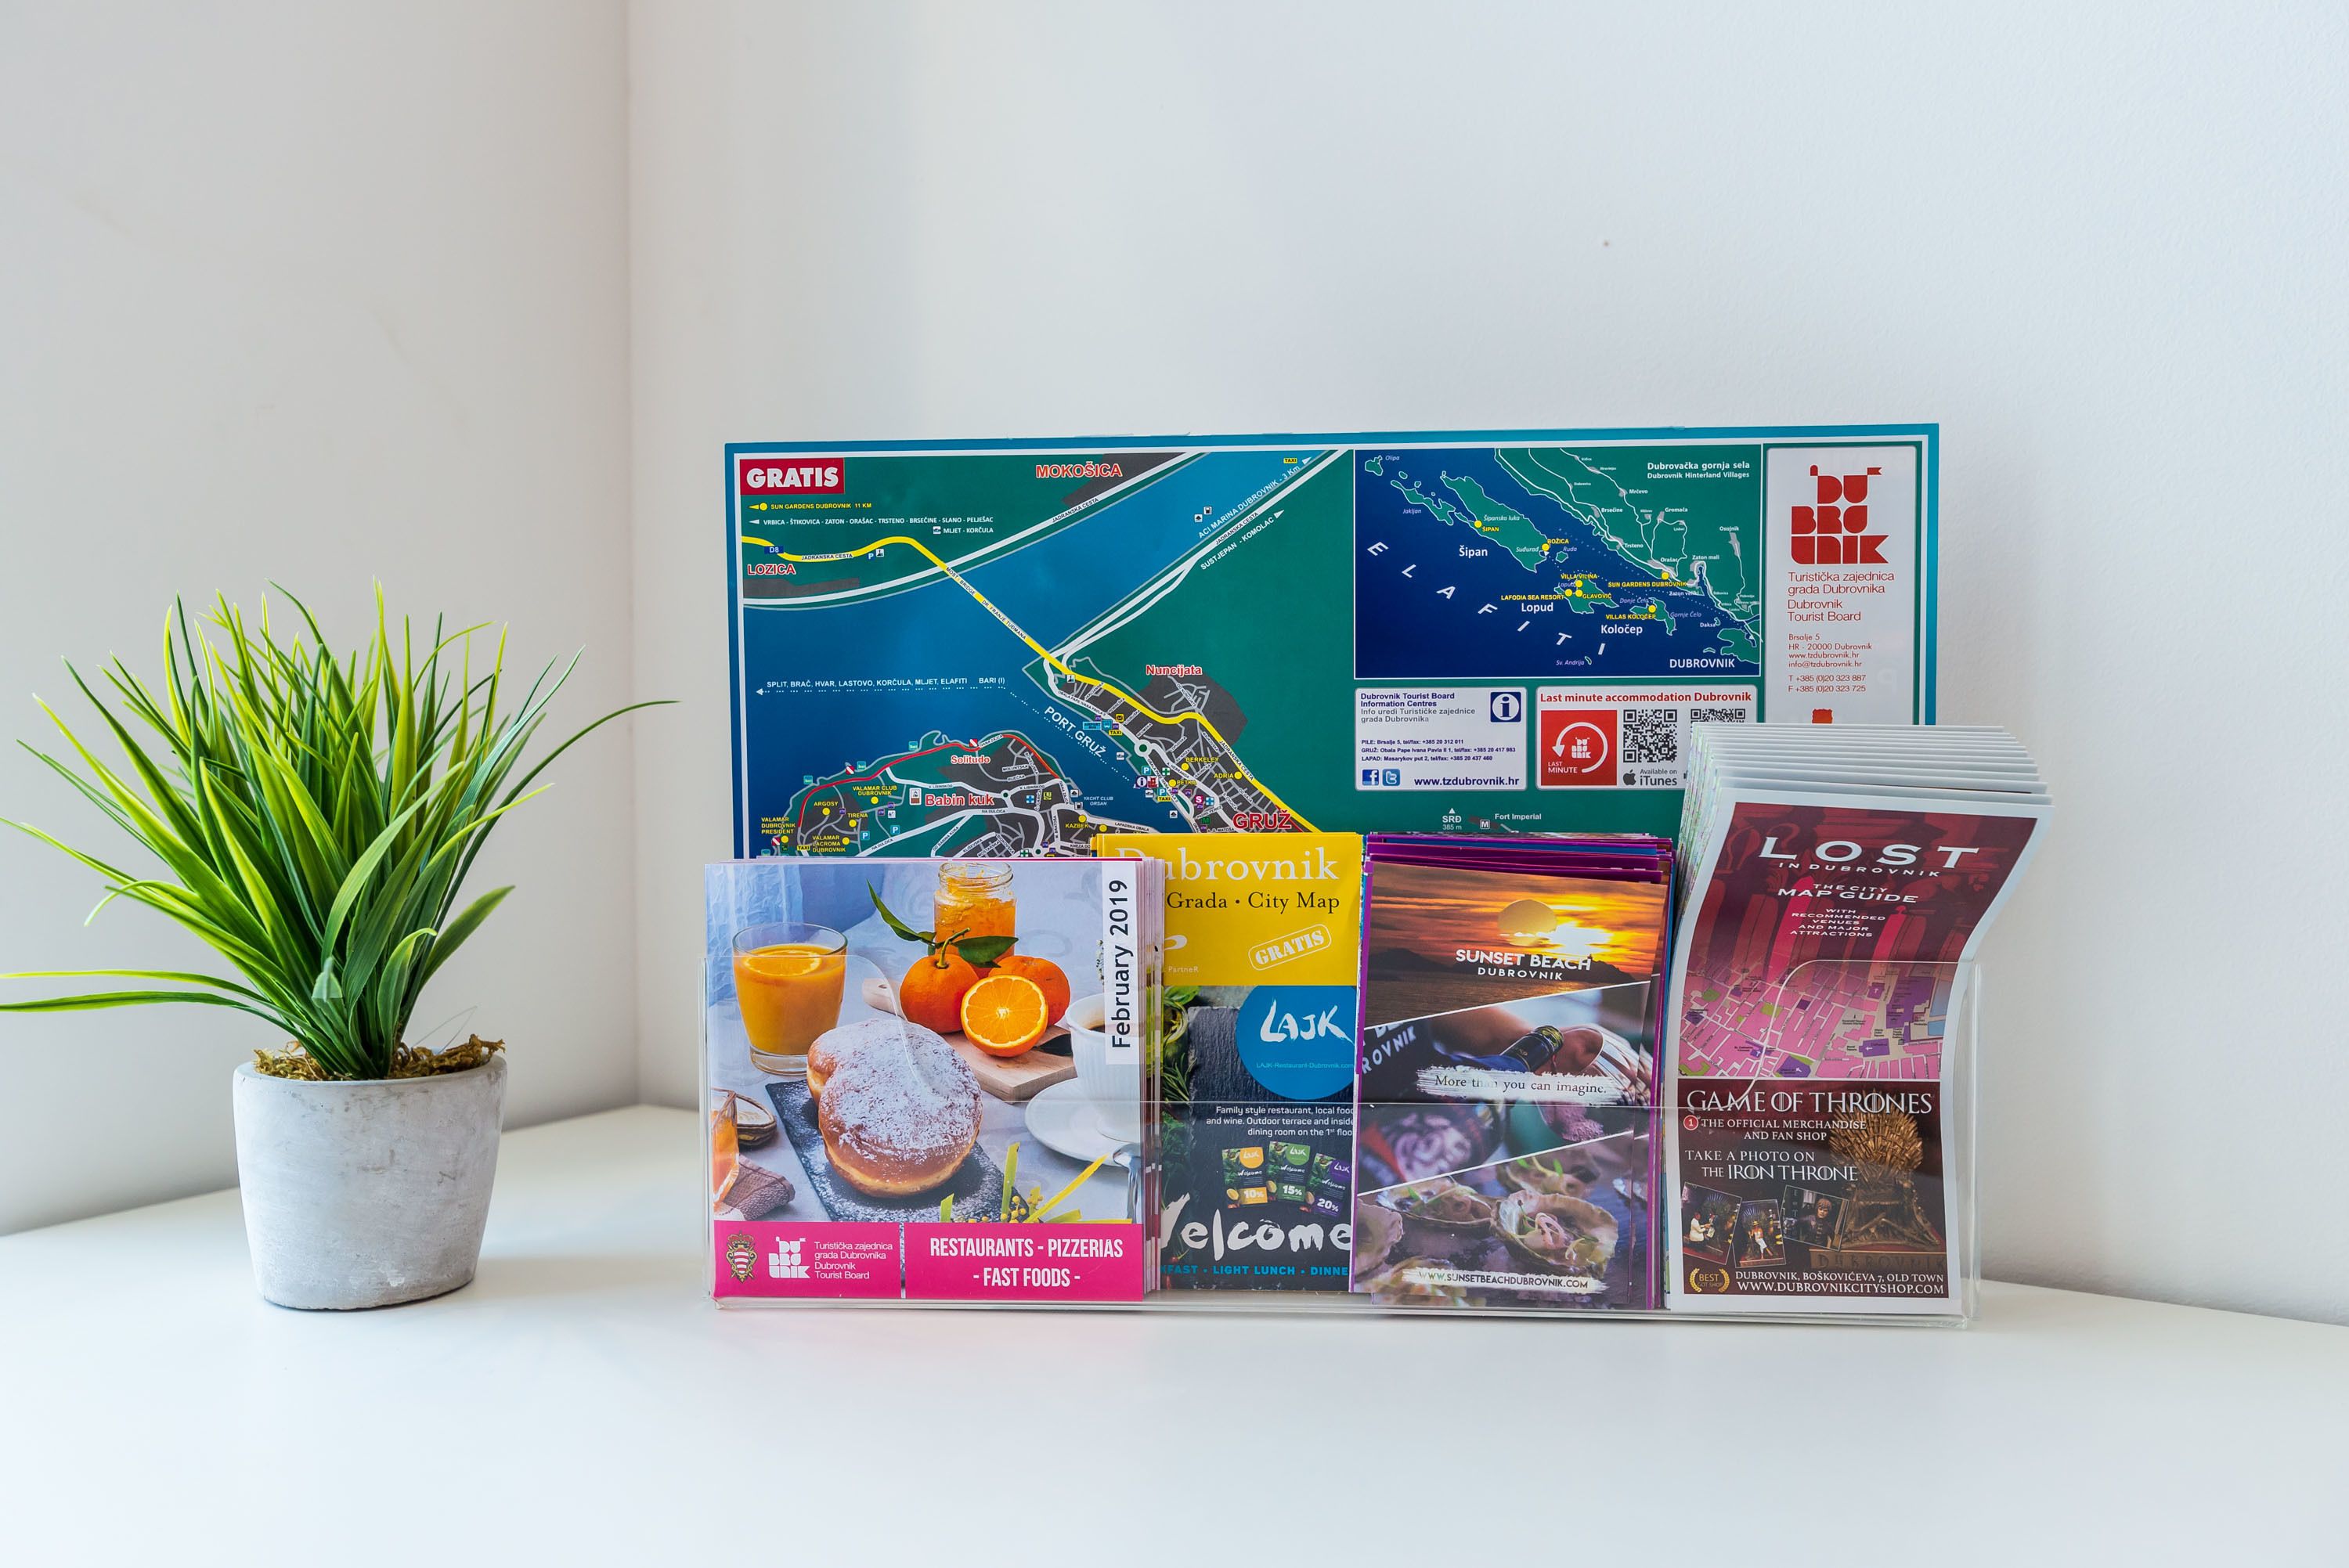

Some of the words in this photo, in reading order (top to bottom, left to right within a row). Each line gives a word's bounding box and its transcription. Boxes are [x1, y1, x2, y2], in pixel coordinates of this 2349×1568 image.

[1035, 461, 1123, 479] MOKOŠICA
[1702, 463, 1730, 472] gornja
[746, 467, 839, 488] GRATIS
[1723, 471, 1749, 480] Villages
[1459, 545, 1488, 558] Šipan
[747, 564, 796, 575] LOZICA
[1788, 571, 1839, 582] Turistička
[1843, 571, 1894, 582] zajednica
[1788, 586, 1819, 596] grada
[1823, 585, 1885, 593] Dubrovnika
[1521, 602, 1553, 614] Lopud
[1788, 600, 1842, 609] Dubrovnik
[1788, 611, 1825, 622] Tourist
[1828, 611, 1861, 621] Board
[1601, 625, 1643, 636] Koločep
[1669, 658, 1735, 668] DUBROVNIK
[1146, 665, 1203, 677] Nuncijata
[877, 678, 913, 687] KORČULA,
[1540, 694, 1562, 702] Last
[1565, 693, 1603, 701] minute
[1605, 692, 1691, 701] accommodation
[1694, 691, 1752, 701] Dubrovnik
[1044, 706, 1075, 733] PORT
[1074, 729, 1107, 758] GRUŽ
[1414, 777, 1519, 786] www.tzdubrovnik.hr
[1640, 776, 1677, 786] iTunes
[925, 795, 964, 807] Babin
[968, 793, 995, 806] kuk
[1232, 809, 1292, 829] GRUŽ
[1758, 837, 1980, 870] LOST
[1809, 863, 1942, 878] DUBROVNIK
[1777, 889, 1832, 898] MAP
[1839, 891, 1919, 903] GUIDE
[1109, 879, 1128, 936] 2019
[1167, 892, 1228, 909] Grada
[1248, 892, 1290, 914] City
[1296, 892, 1340, 914] Map
[1792, 912, 1886, 921] RECOMMENDED
[1254, 929, 1324, 965] GRATIS
[1456, 948, 1525, 968] SUNSET
[1530, 953, 1591, 971] BEACH
[1478, 967, 1563, 981] DUBROVNIK
[1111, 945, 1134, 1047] February
[1260, 997, 1355, 1047] LAJK
[1435, 1075, 1467, 1087] More
[1503, 1080, 1525, 1092] you
[1531, 1082, 1551, 1090] can
[1557, 1080, 1607, 1096] imagine.
[1687, 1090, 1765, 1112] GAME
[1771, 1091, 1802, 1112] OF
[1809, 1091, 1932, 1114] THRONES
[1216, 1106, 1243, 1116] Family
[1245, 1106, 1266, 1115] style
[1701, 1119, 1724, 1128] THE
[1727, 1119, 1780, 1129] OFFICIAL
[1782, 1119, 1867, 1130] MERCHANDISE
[1247, 1128, 1272, 1137] dining
[1744, 1131, 1770, 1140] AND
[1772, 1131, 1794, 1140] FAN
[1797, 1132, 1827, 1141] SHOP
[1685, 1150, 1722, 1161] TAKE
[1727, 1151, 1736, 1161] A
[1740, 1151, 1790, 1162] PHOTO
[1794, 1152, 1815, 1162] ON
[1701, 1167, 1724, 1177] THE
[1727, 1165, 1773, 1180] IRON
[1778, 1165, 1858, 1182] THRONE
[1243, 1189, 1265, 1199] 10%
[1283, 1185, 1302, 1195] 15%
[1317, 1199, 1339, 1212] 20%
[814, 1242, 853, 1250] Turistička
[855, 1242, 893, 1251] zajednica
[930, 1238, 1034, 1257] RESTAURANTS
[1048, 1238, 1123, 1257] PIZZERIAS
[840, 1251, 886, 1260] Dubrovnika
[1214, 1266, 1249, 1275] LIGHT
[1254, 1266, 1295, 1275] LUNCH
[1735, 1271, 1800, 1281] DUBROVNIK,
[1802, 1271, 1875, 1282] BOŠKOVIĆEVA
[1886, 1274, 1908, 1282] OLD
[1911, 1274, 1943, 1282] TOWN
[983, 1267, 1019, 1286] FAST
[1023, 1268, 1070, 1287] FOODS
[1419, 1271, 1589, 1289] WWW.SUNSETBEACHDUBROVNIK.COM
[1698, 1274, 1719, 1282] BEST
[1737, 1281, 1944, 1295] WWW.DUBROVNIKCITYSHOP.COM
